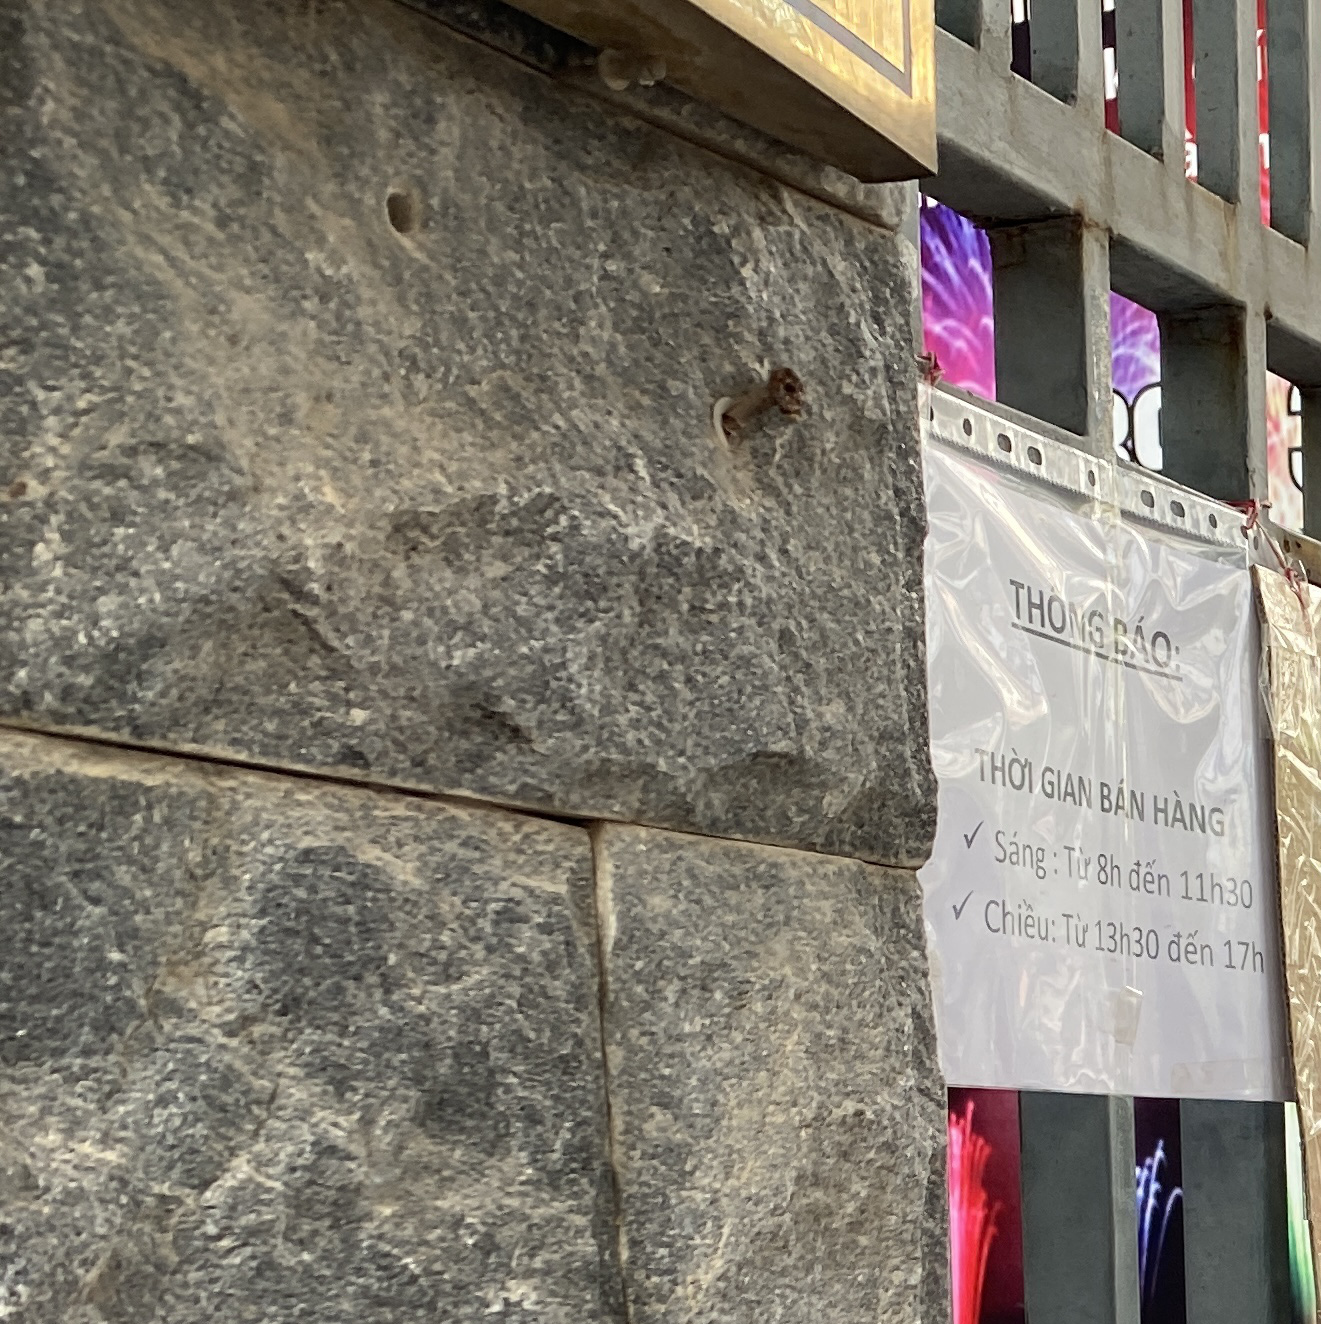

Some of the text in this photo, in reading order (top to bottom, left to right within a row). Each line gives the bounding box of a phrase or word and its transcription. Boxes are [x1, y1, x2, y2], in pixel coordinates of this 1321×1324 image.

[1113, 615, 1181, 673] BÁO:
[974, 747, 1225, 837] THỜI GIAN BÁN HÀNG
[994, 830, 1046, 880] Sáng
[1063, 845, 1092, 881] Từ
[1097, 853, 1122, 889] 8h
[1128, 859, 1171, 897] đến
[1179, 870, 1254, 909] 11h30
[984, 899, 1265, 974] Chiều: Từ 13h30 đến 17h
